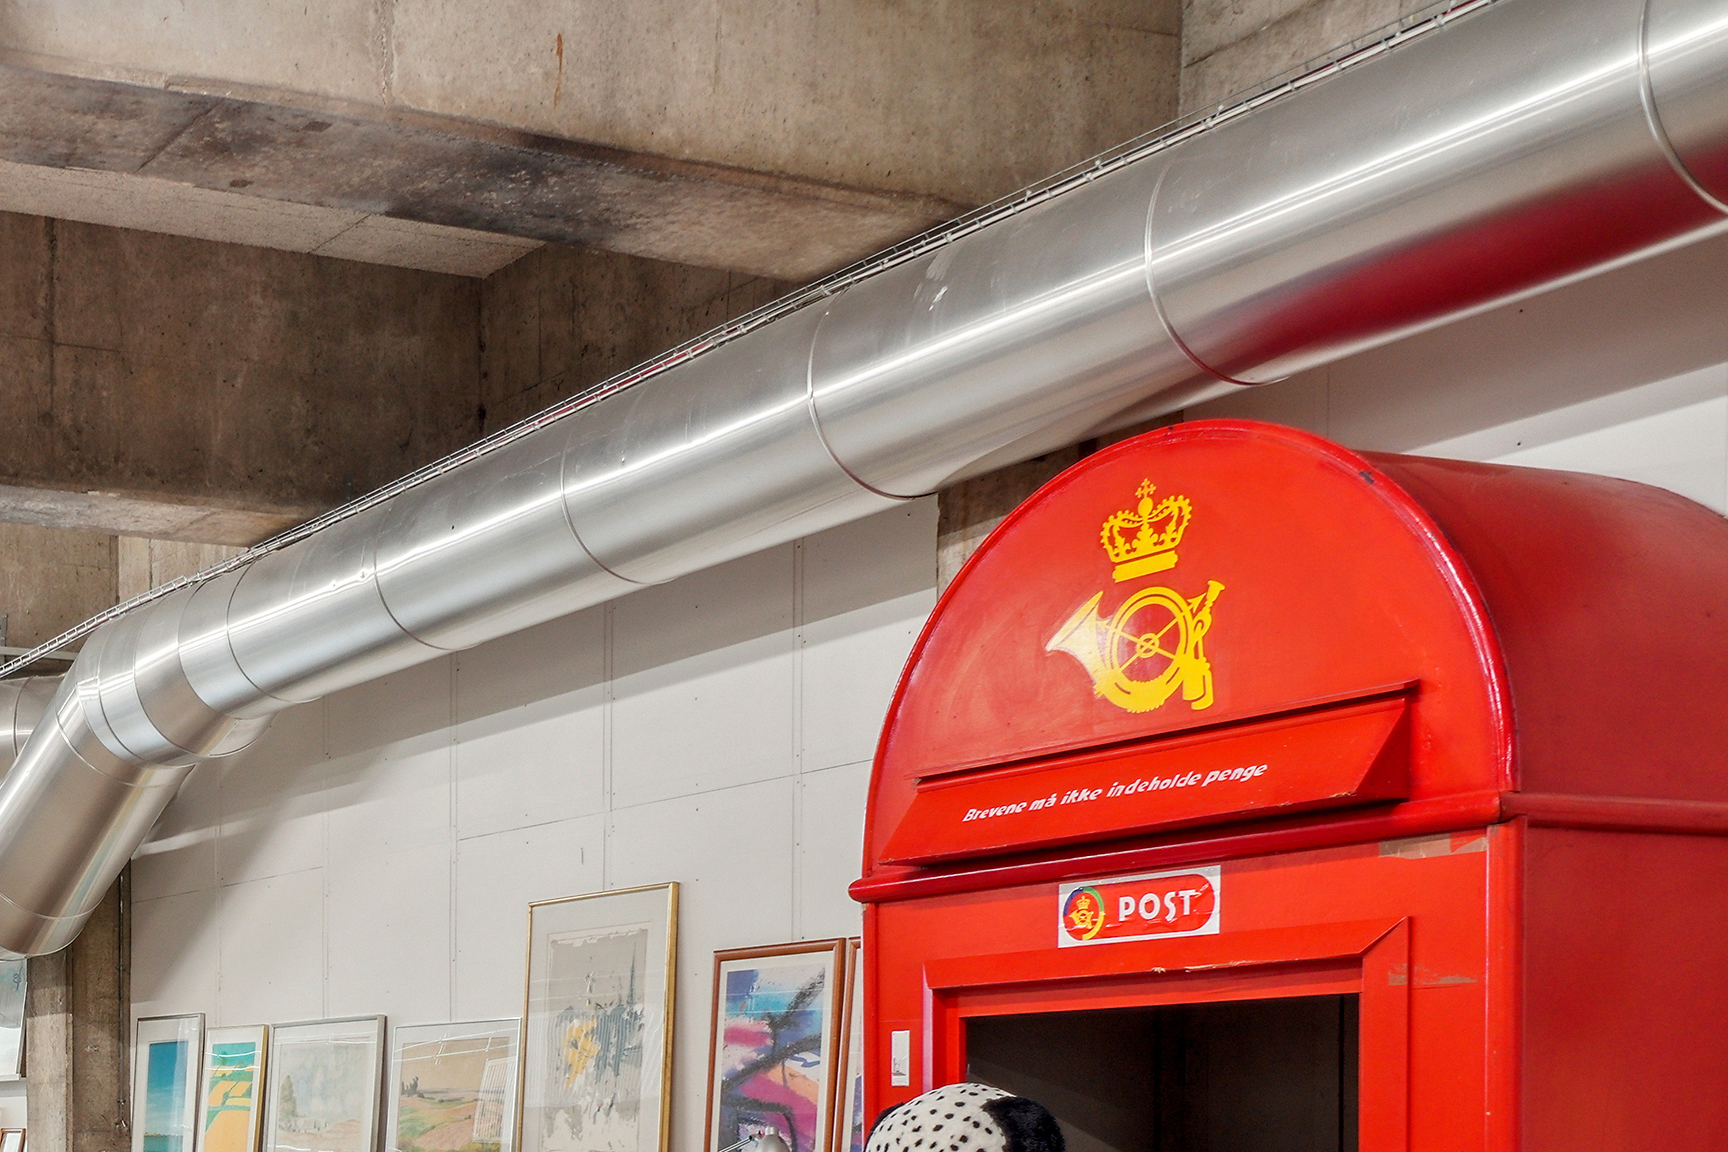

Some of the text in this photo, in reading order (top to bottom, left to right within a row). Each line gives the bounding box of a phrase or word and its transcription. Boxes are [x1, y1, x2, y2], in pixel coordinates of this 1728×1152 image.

[962, 763, 1268, 822] Brevene må ikke indeholde penge
[1118, 889, 1198, 922] POST
